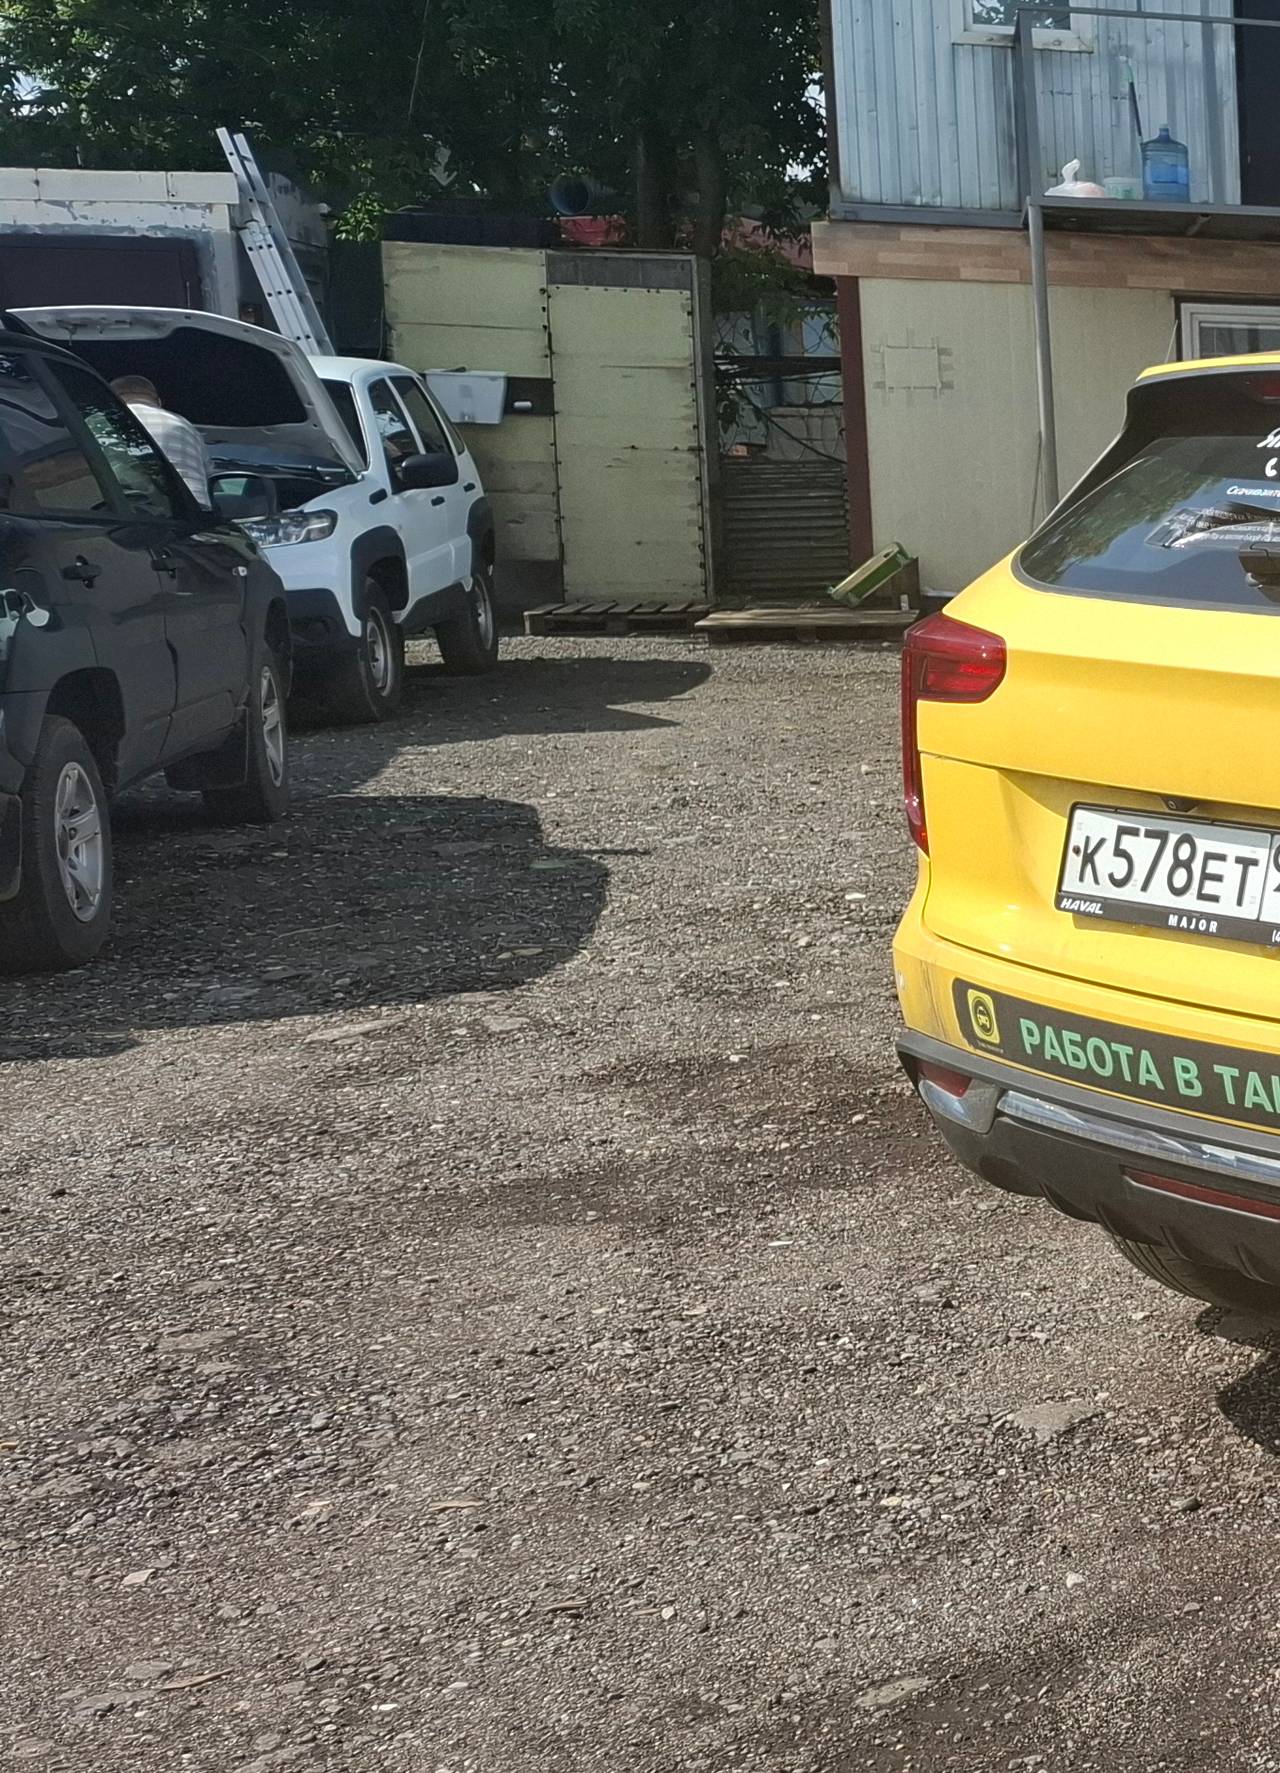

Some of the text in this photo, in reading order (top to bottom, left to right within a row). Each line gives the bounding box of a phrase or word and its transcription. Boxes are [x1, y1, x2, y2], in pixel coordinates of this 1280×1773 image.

[1060, 897, 1104, 915] HAVAL
[1168, 914, 1218, 933] MAJOR
[1020, 1017, 1165, 1091] РАБОТА
[1173, 1055, 1203, 1098] В
